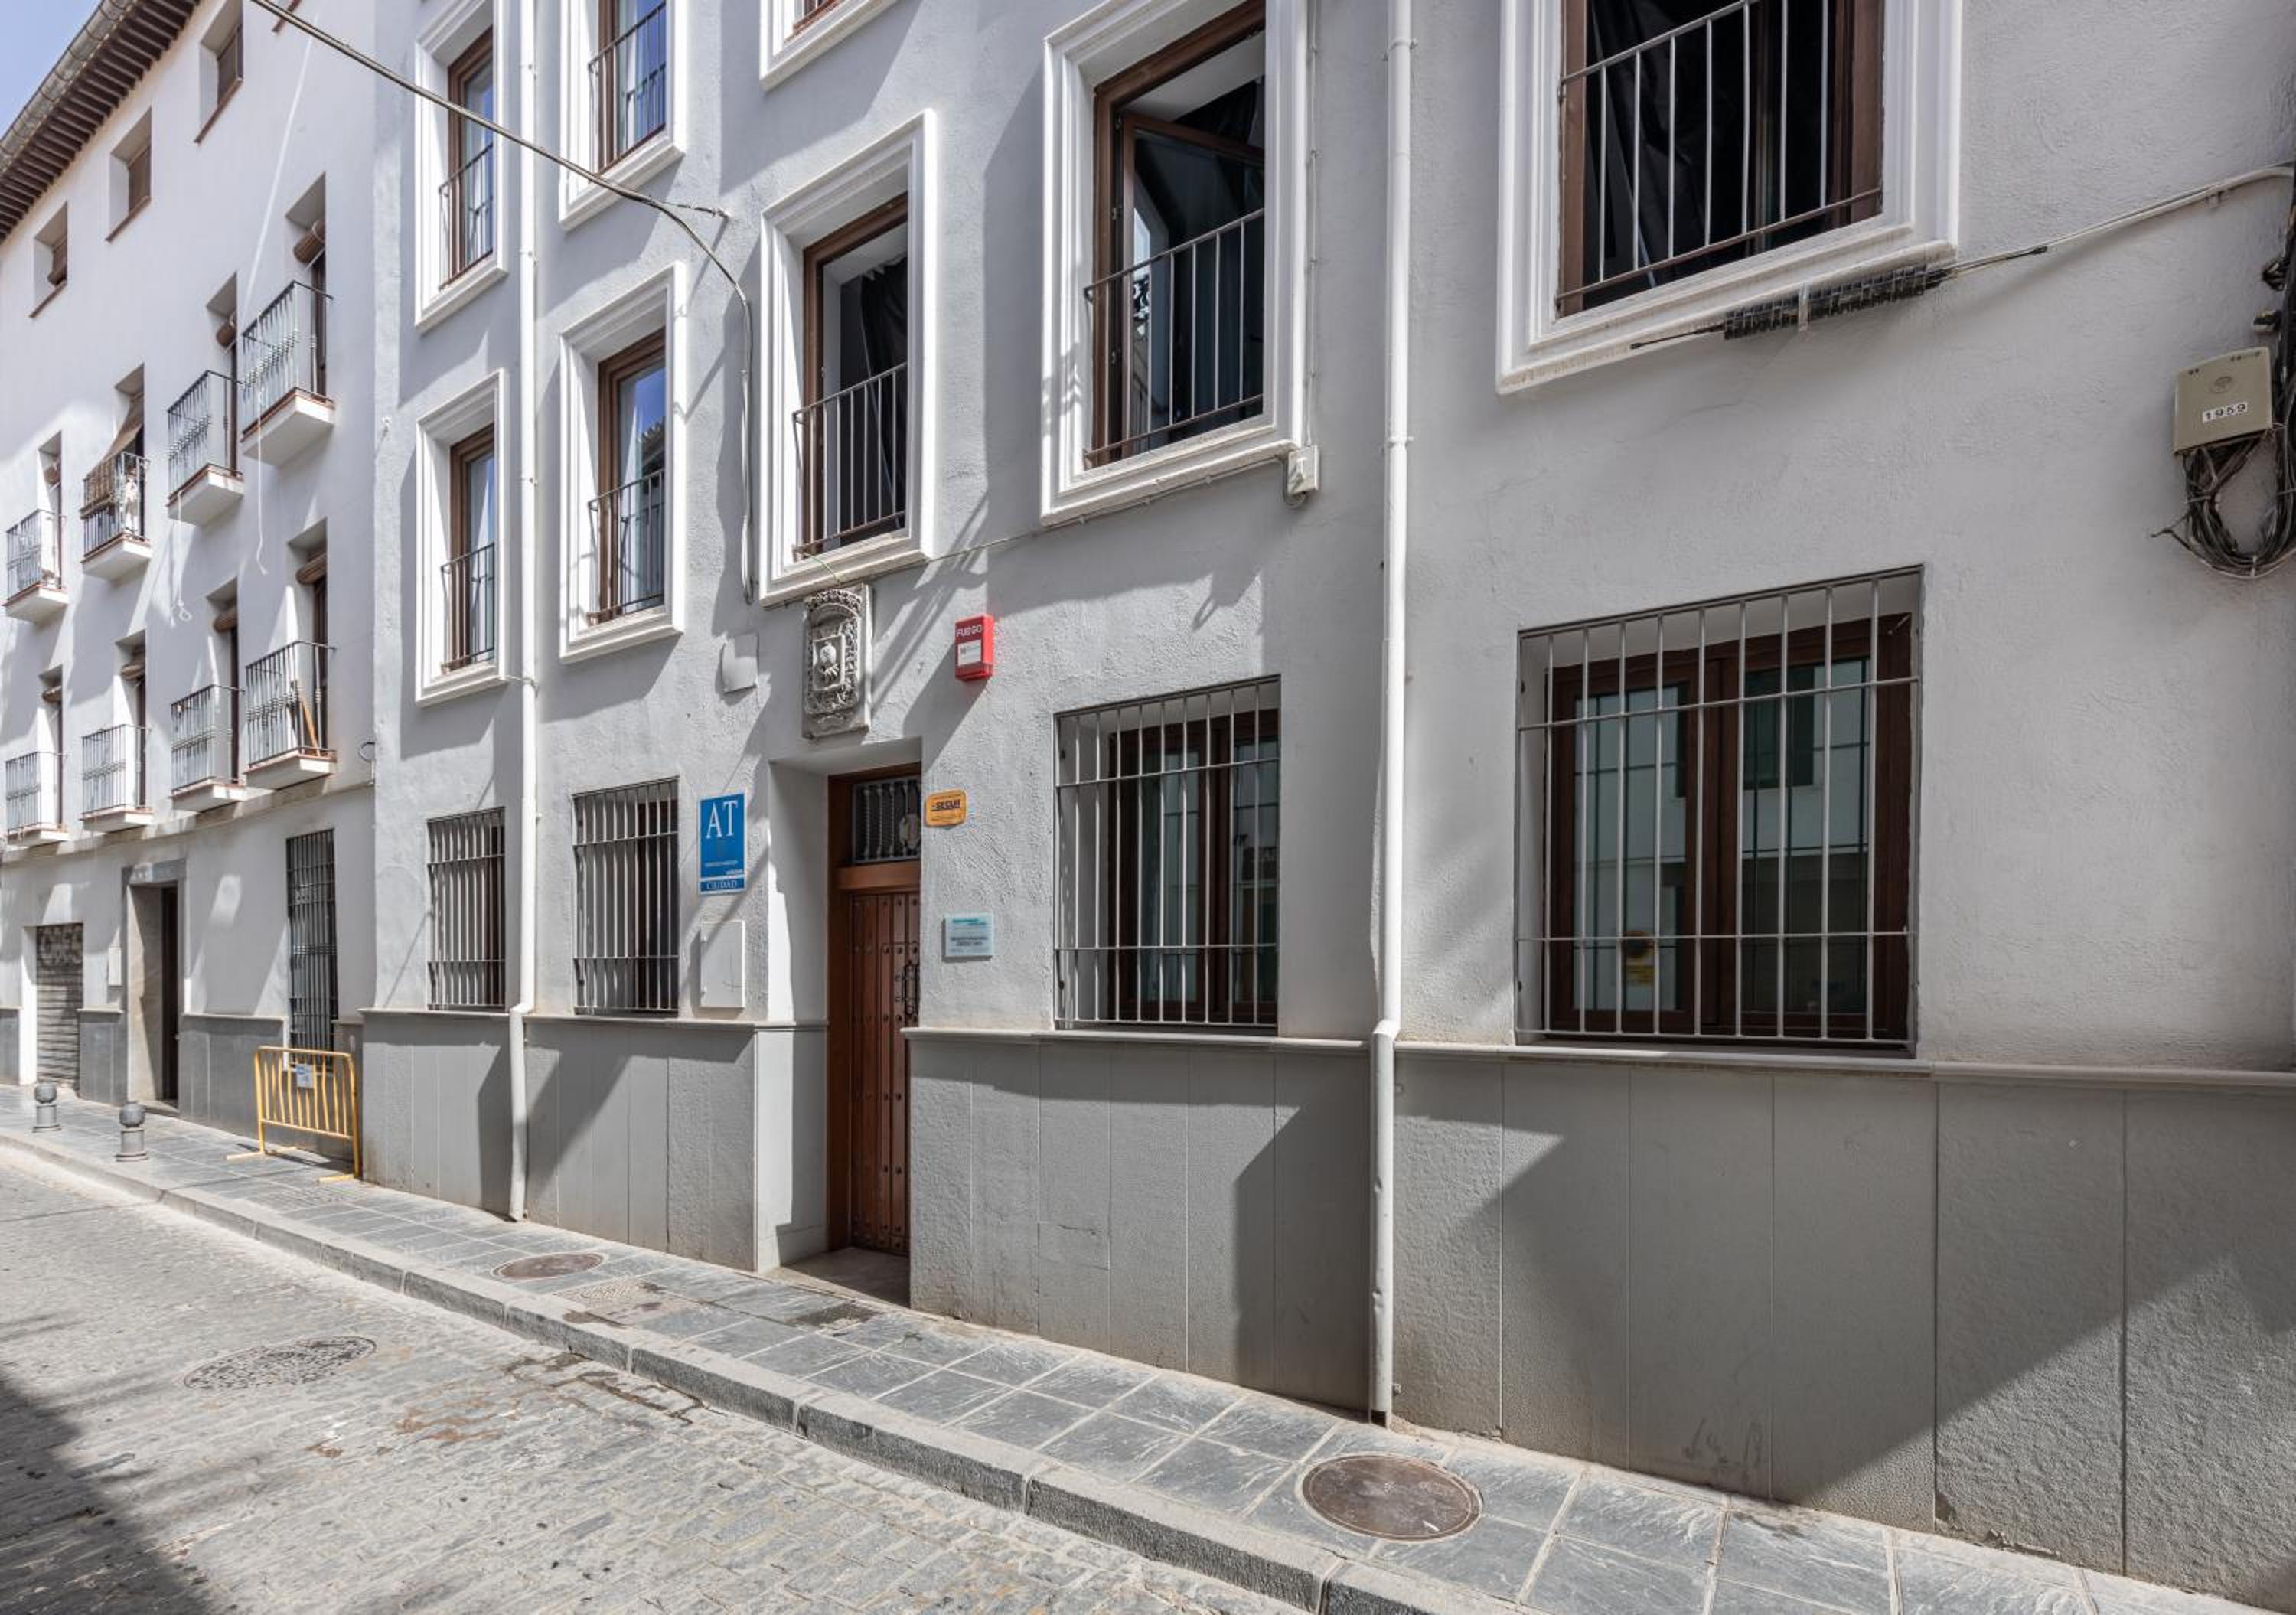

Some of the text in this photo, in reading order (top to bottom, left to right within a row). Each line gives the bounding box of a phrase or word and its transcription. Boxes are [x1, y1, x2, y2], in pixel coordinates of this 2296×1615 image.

[956, 624, 982, 637] FUEGO
[706, 800, 739, 839] AT
[706, 879, 737, 889] CIUDAD
